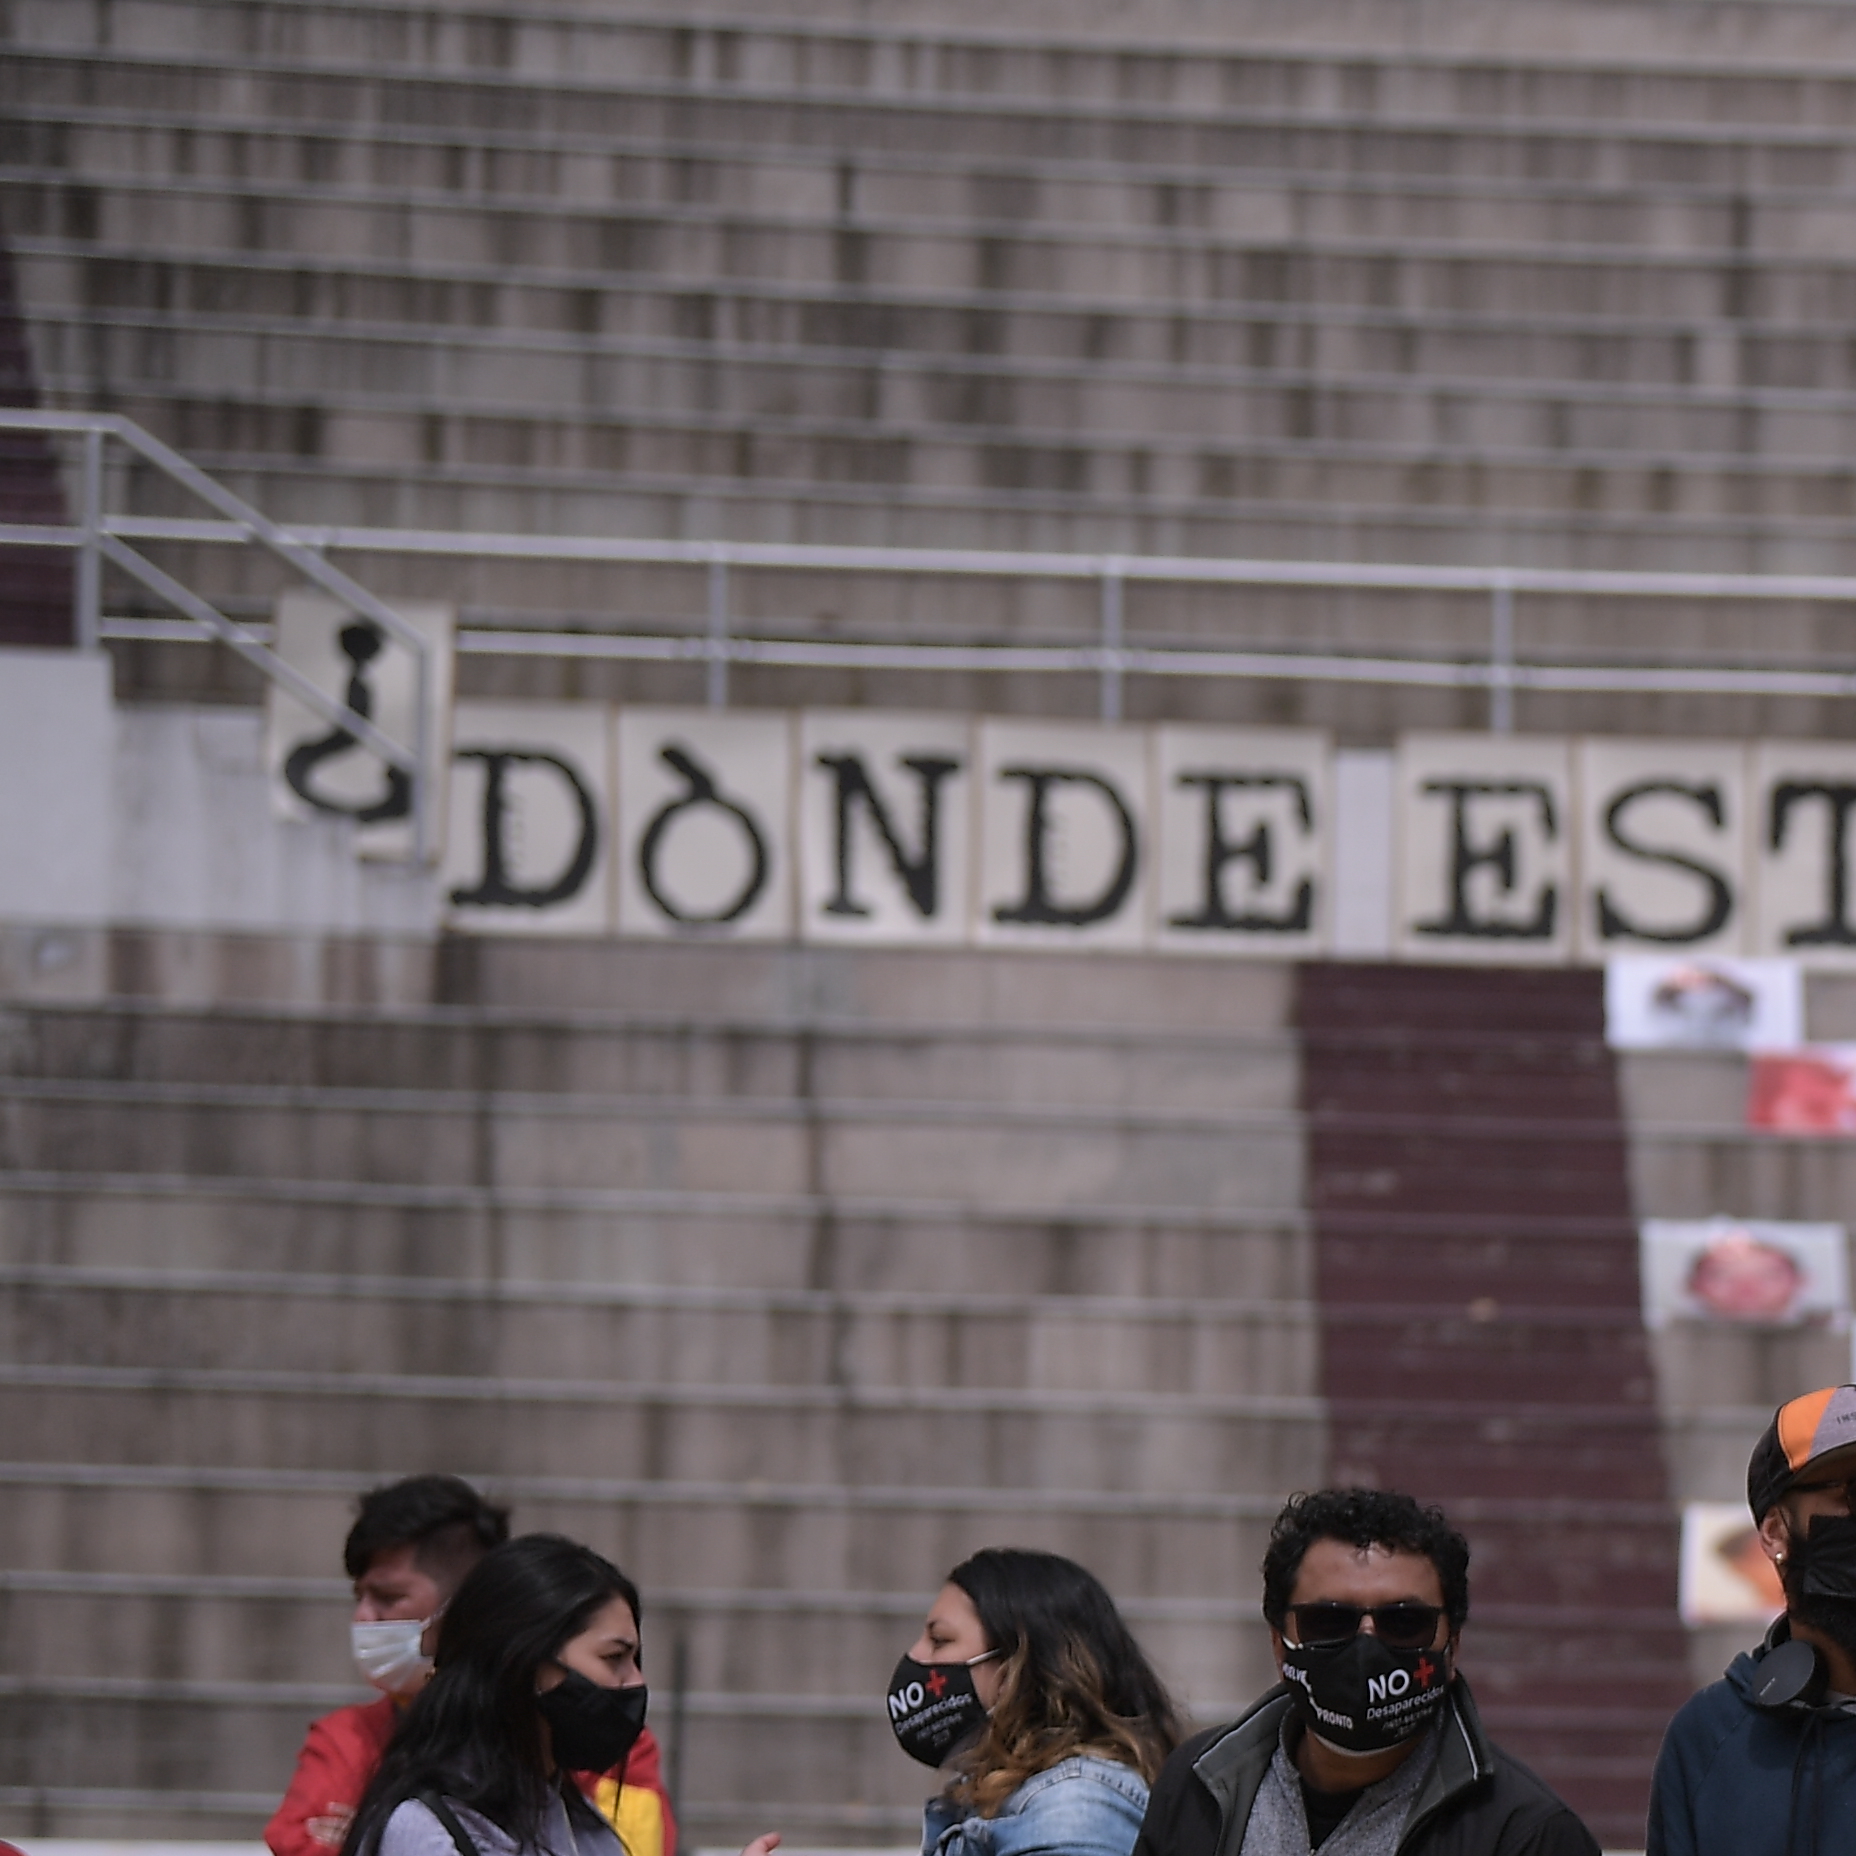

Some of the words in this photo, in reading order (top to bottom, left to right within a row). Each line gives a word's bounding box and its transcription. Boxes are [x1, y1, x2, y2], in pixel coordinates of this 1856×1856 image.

[888, 1681, 925, 1720] NO
[1366, 1684, 1444, 1720] Desaparecidos
[1367, 1668, 1410, 1703] NO
[895, 1693, 972, 1735] Desaparecidos
[1316, 1707, 1353, 1730] PRONTO
